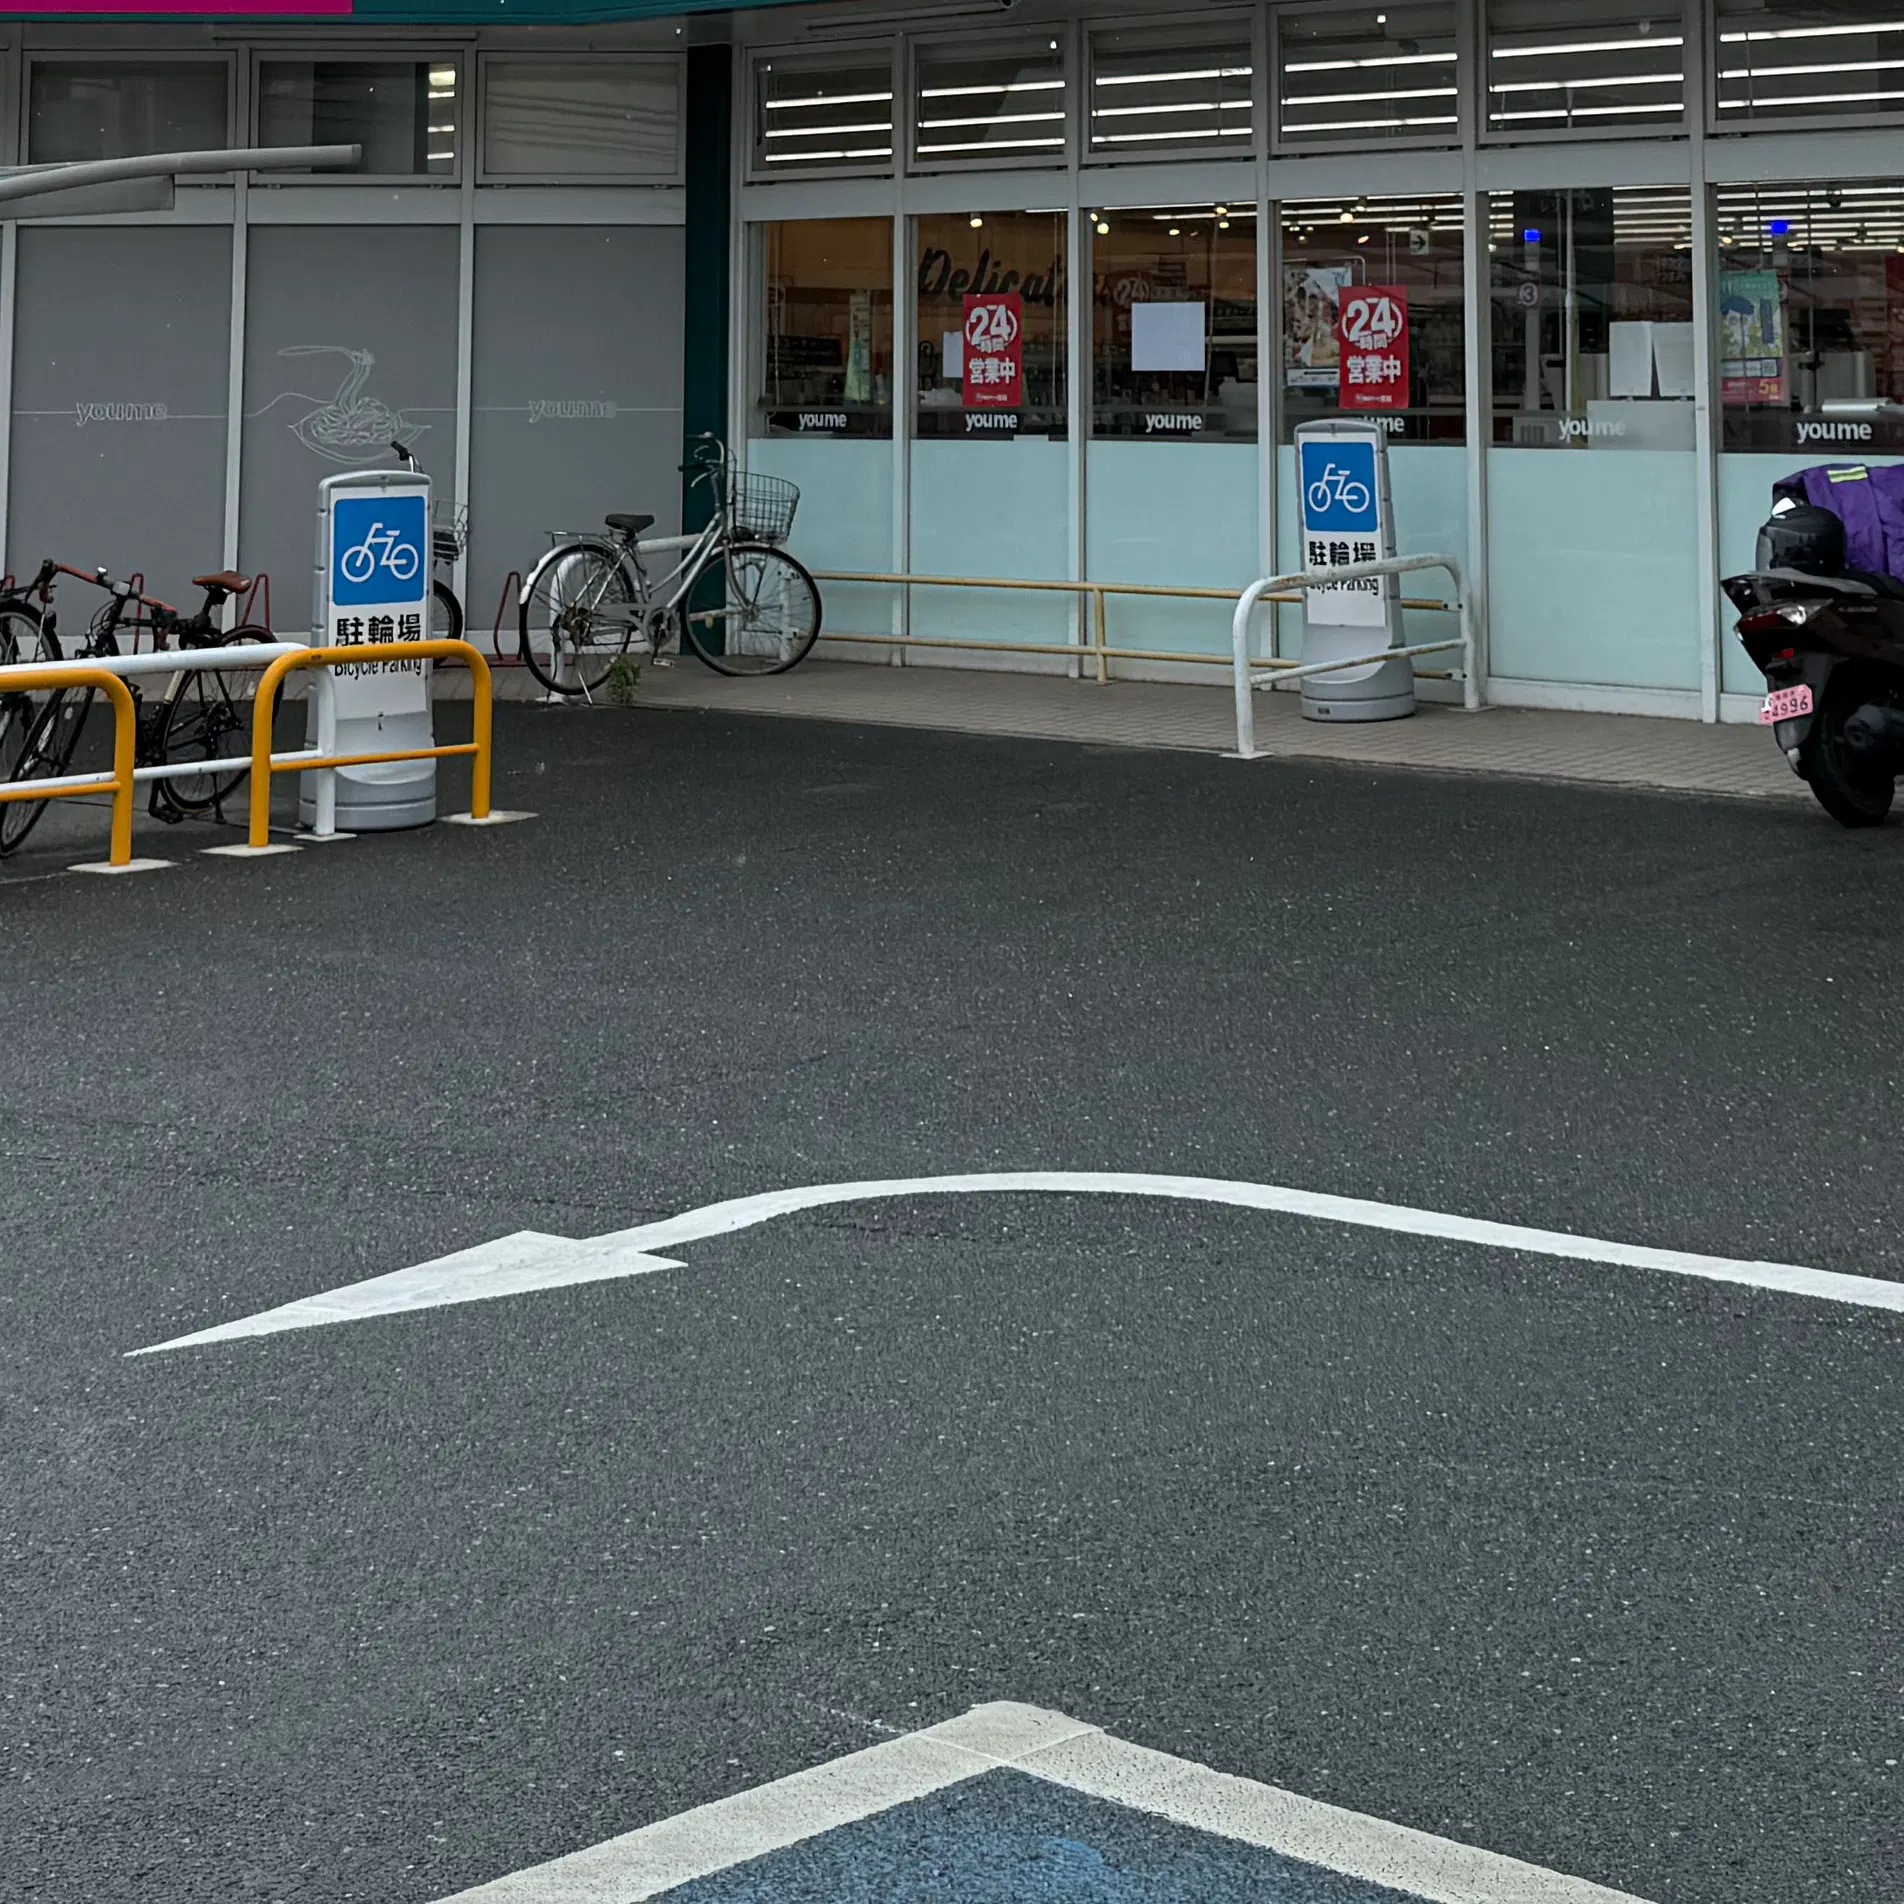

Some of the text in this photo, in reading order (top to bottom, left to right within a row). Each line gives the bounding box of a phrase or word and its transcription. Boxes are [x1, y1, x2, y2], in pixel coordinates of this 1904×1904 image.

[970, 304, 1012, 346] 24
[1347, 297, 1396, 342] 24
[979, 338, 1006, 353] 時間
[1359, 333, 1388, 350] 時間
[969, 357, 1016, 384] 営業中
[1347, 355, 1401, 384] 営業中
[75, 402, 168, 427] youme
[798, 412, 848, 431] youme
[965, 413, 1018, 432] youme
[1145, 412, 1203, 433] youme
[1558, 416, 1627, 441] youme
[1796, 421, 1873, 444] youme
[1309, 541, 1377, 566] 駐輪場
[335, 613, 421, 646] 駐輪場
